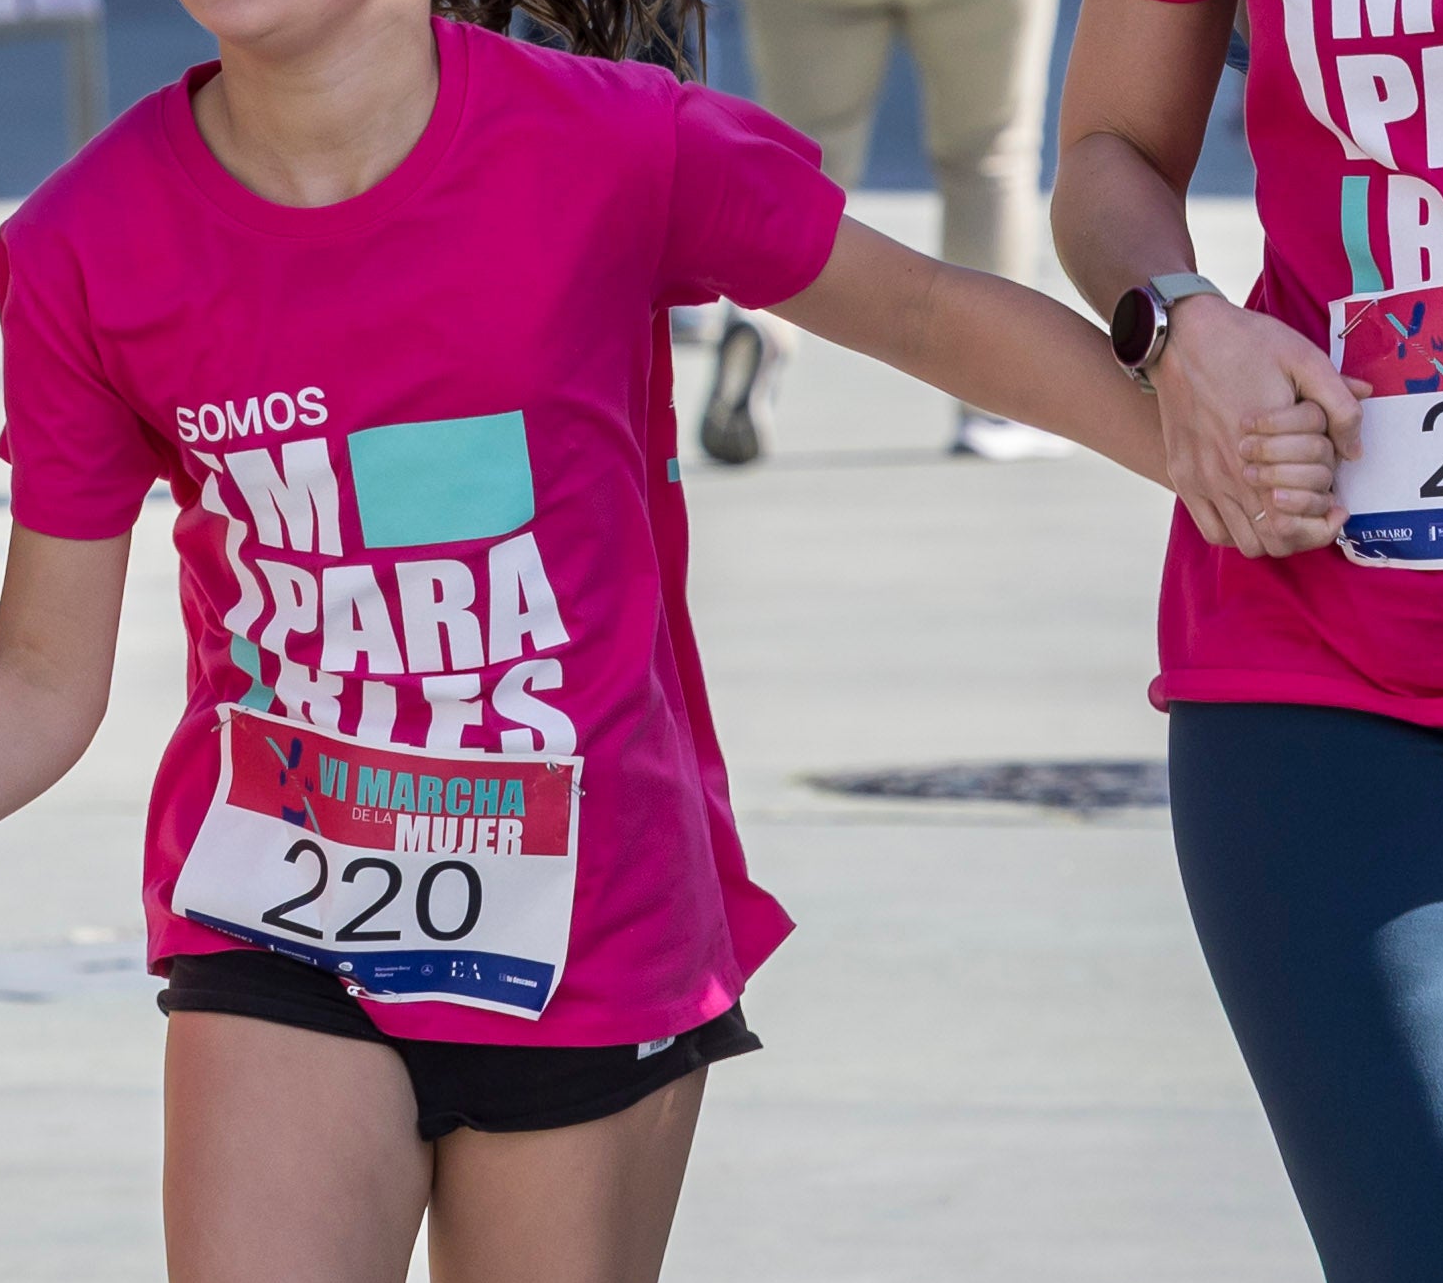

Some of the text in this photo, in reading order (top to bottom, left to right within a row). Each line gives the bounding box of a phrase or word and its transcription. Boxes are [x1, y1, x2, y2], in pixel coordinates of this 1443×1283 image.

[175, 385, 329, 444] SOMOS
[316, 754, 526, 817] VI MARCHA
[351, 806, 524, 856] DE LA MUJER
[260, 838, 484, 944] 220
